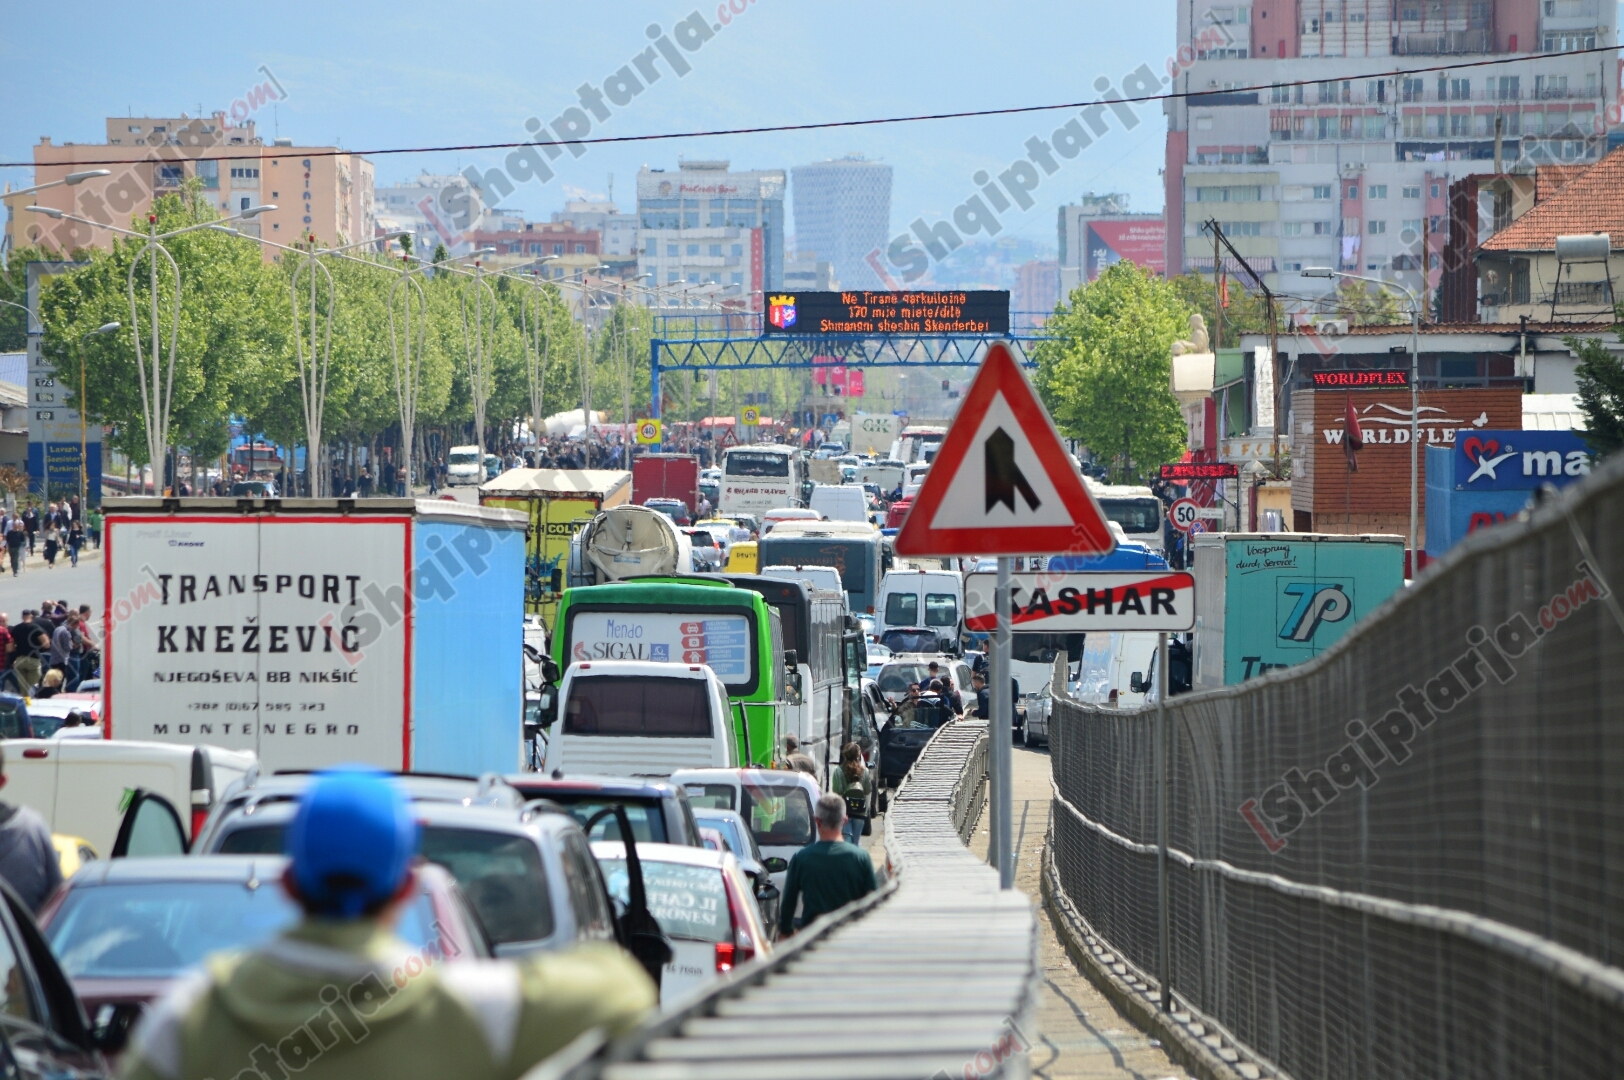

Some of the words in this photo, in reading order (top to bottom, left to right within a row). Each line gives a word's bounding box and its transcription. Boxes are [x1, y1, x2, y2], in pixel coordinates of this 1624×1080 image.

[849, 306, 868, 319] 170
[1313, 372, 1407, 385] WORLDFLEX
[644, 427, 657, 437] 40
[1322, 428, 1475, 444] WRLDFLE
[1177, 506, 1195, 522] 50
[157, 574, 361, 606] TRANSPORT
[994, 587, 1178, 616] KASHAR
[157, 615, 360, 653] KNEŽEVIĆ
[607, 618, 644, 639] Mendo
[593, 642, 650, 661] SIGAL
[153, 669, 258, 684] NJEGOŠEVA
[266, 671, 291, 683] BB
[299, 669, 359, 684] NIKŠIĆ
[153, 723, 359, 735] MONTENEGRO
